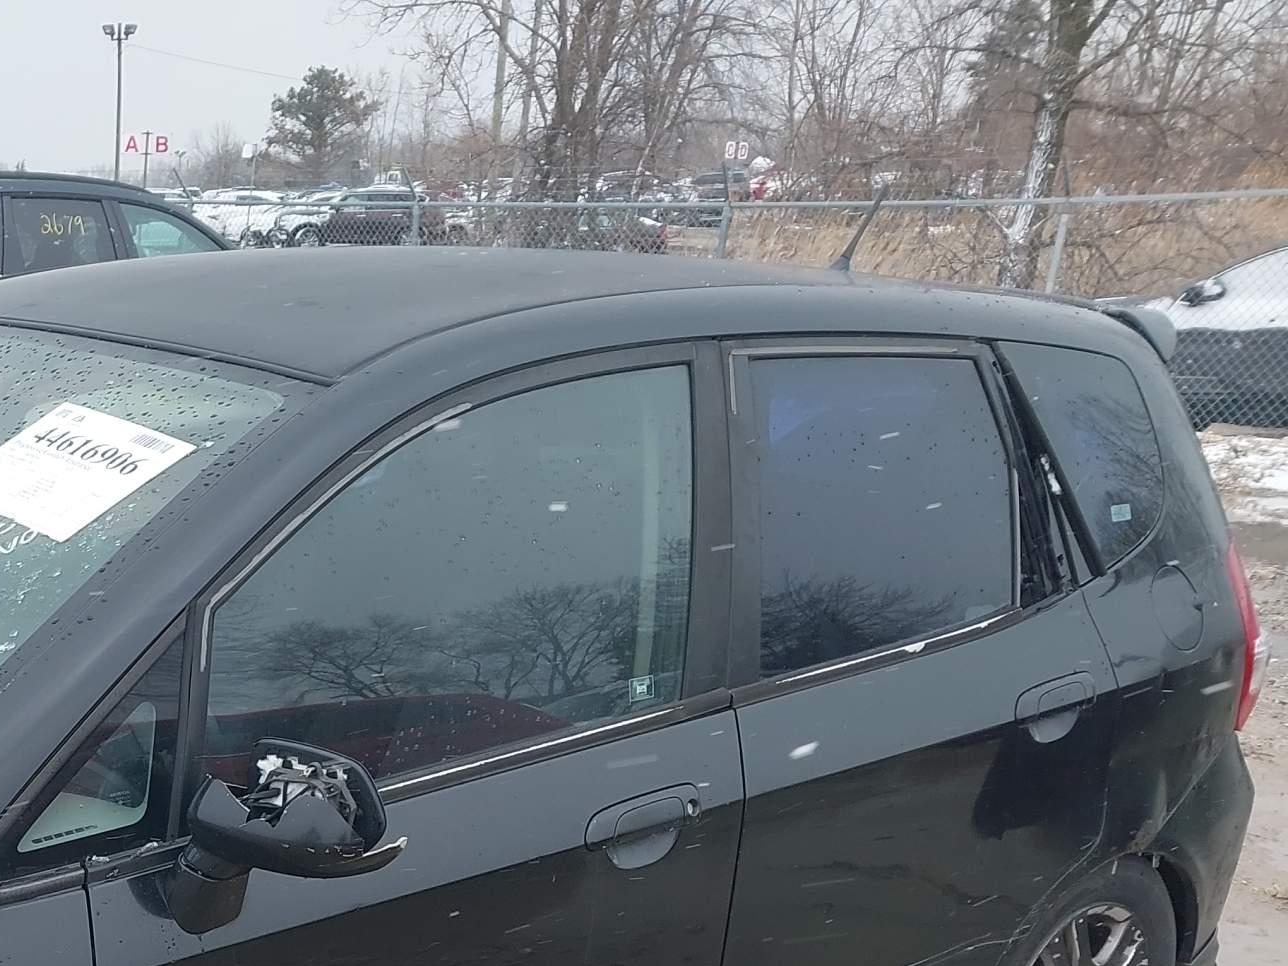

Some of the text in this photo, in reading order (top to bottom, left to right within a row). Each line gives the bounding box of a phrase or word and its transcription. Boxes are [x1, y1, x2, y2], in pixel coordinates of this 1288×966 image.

[124, 135, 168, 153] A B
[39, 212, 85, 236] 2679
[34, 427, 149, 475] 44616906
